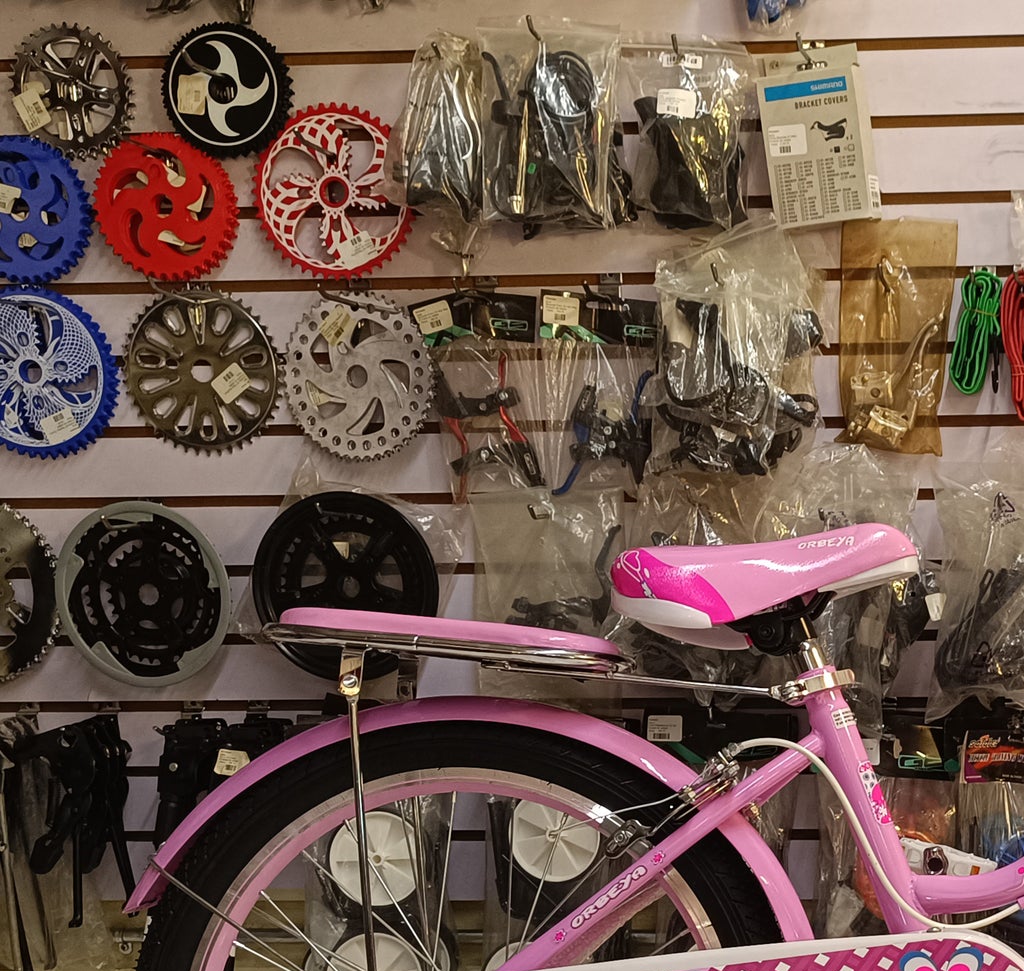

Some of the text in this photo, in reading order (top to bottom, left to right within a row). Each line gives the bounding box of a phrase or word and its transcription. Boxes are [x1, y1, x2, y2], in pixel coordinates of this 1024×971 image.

[810, 80, 843, 92] SHIMANO
[795, 95, 849, 110] BRACKET COVERS
[797, 535, 855, 550] ORBEYA
[570, 865, 648, 929] ORBEYA
